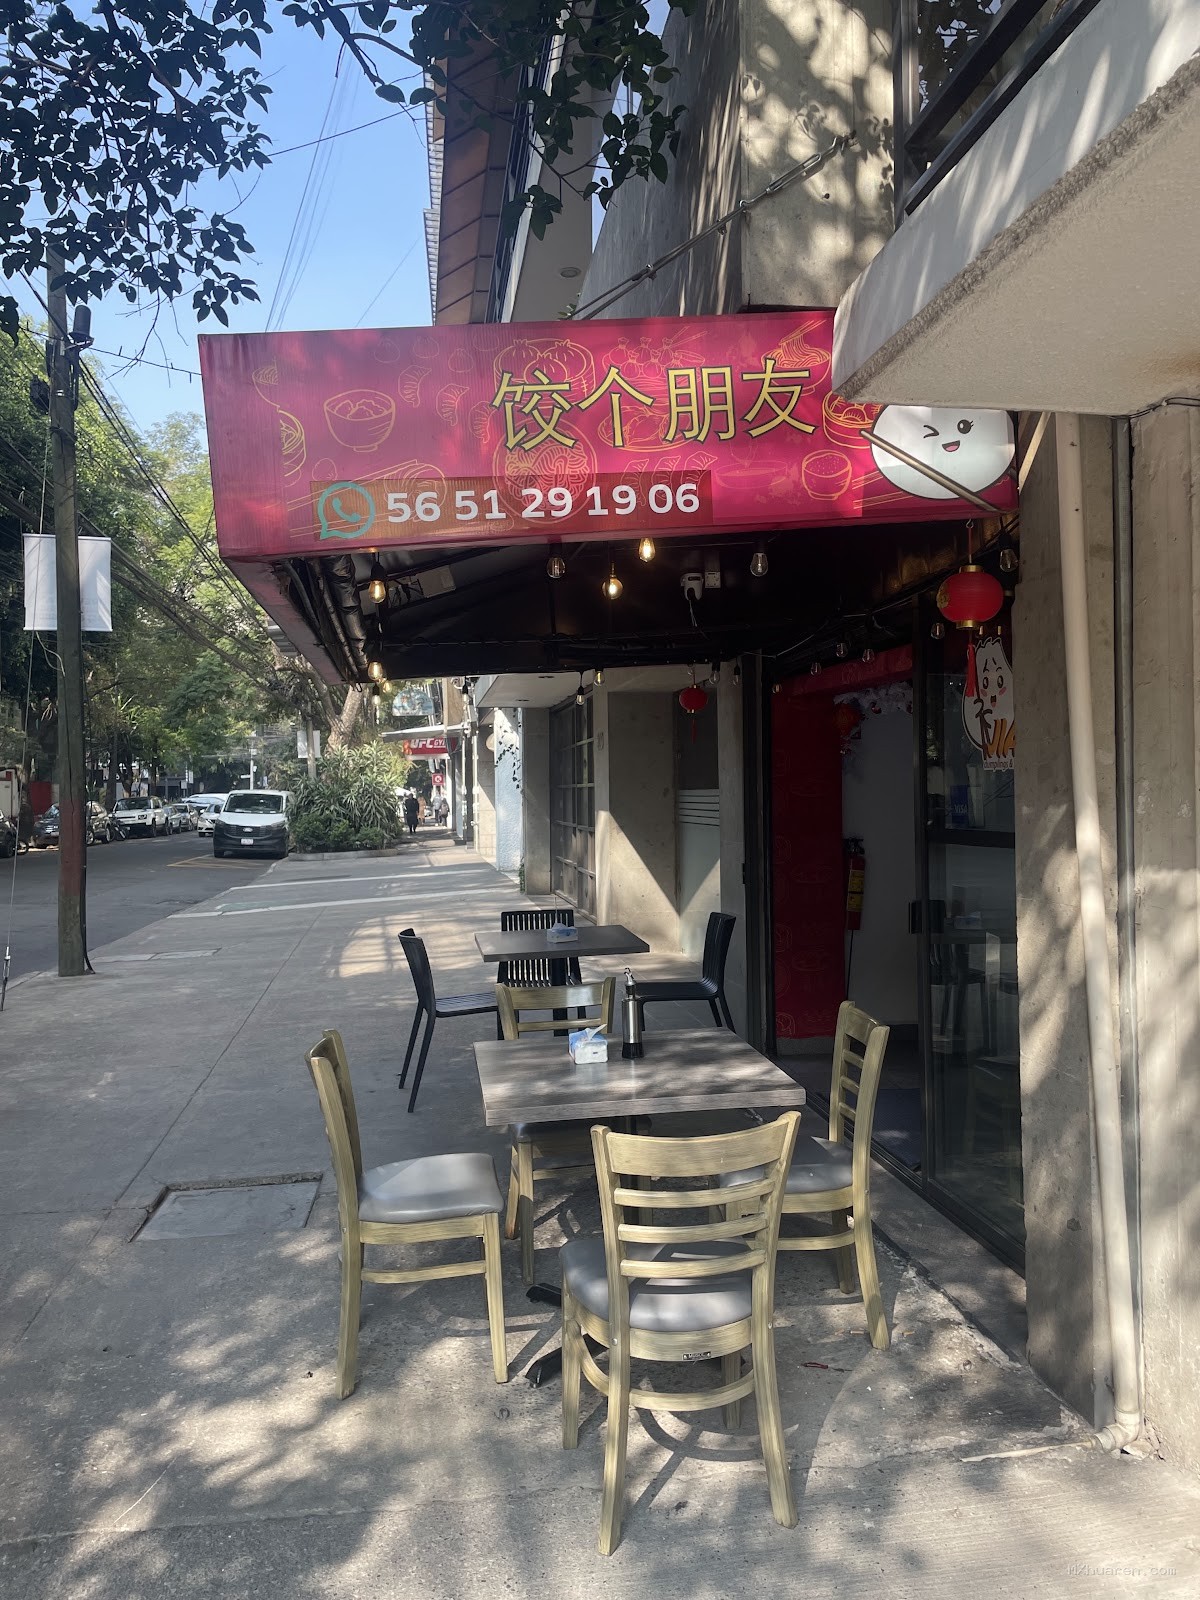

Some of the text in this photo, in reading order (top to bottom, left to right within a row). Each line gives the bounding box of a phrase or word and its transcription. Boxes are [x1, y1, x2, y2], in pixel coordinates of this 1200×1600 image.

[491, 357, 819, 452] 饺个朋友
[387, 483, 700, 523] 56 51 29 19 06
[411, 738, 434, 748] UFC
[954, 804, 968, 814] VISA
